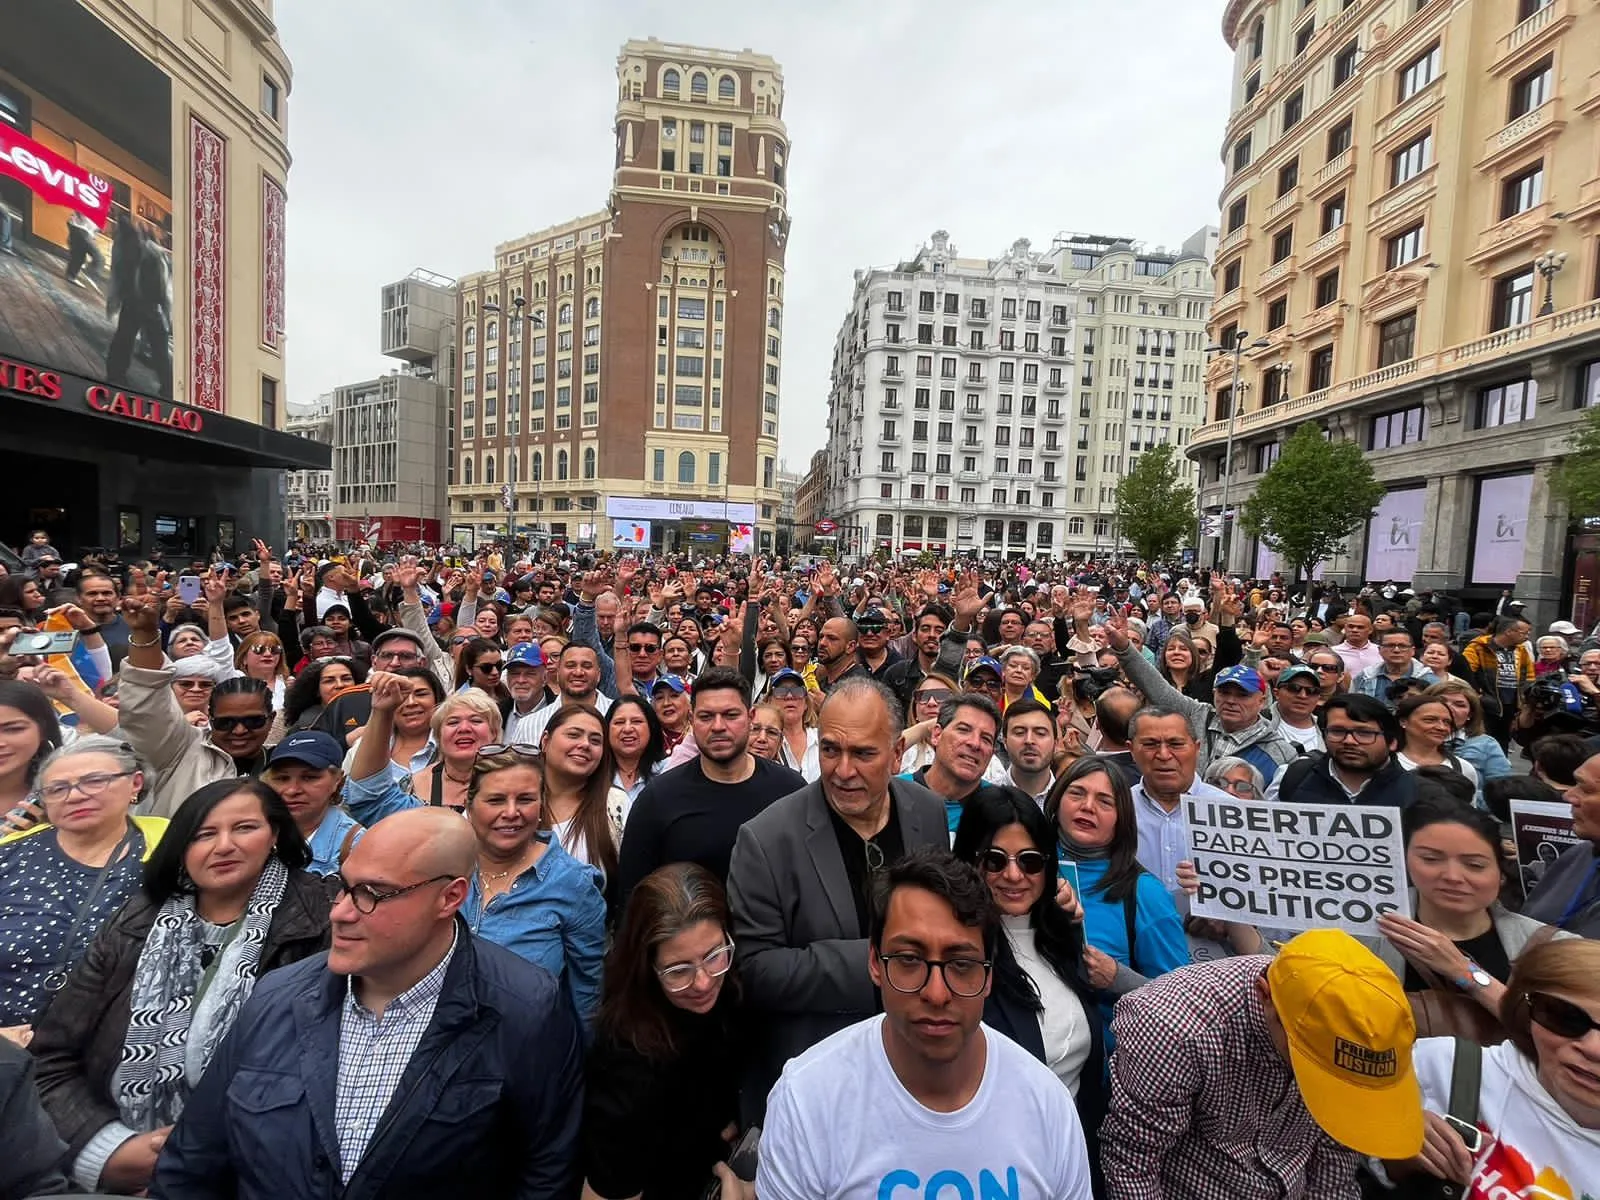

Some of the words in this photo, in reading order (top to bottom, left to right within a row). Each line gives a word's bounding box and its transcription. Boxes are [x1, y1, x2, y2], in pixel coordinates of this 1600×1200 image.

[86, 385, 203, 432] CALLAO
[1188, 801, 1393, 840] LIBERTAD
[1192, 830, 1271, 856] PARA
[1278, 839, 1391, 865] TODOS
[1194, 857, 1250, 882] LOS
[1259, 866, 1395, 895] PRESOS
[1197, 882, 1399, 923] POLÍTICOS
[877, 1166, 1020, 1200] CON
